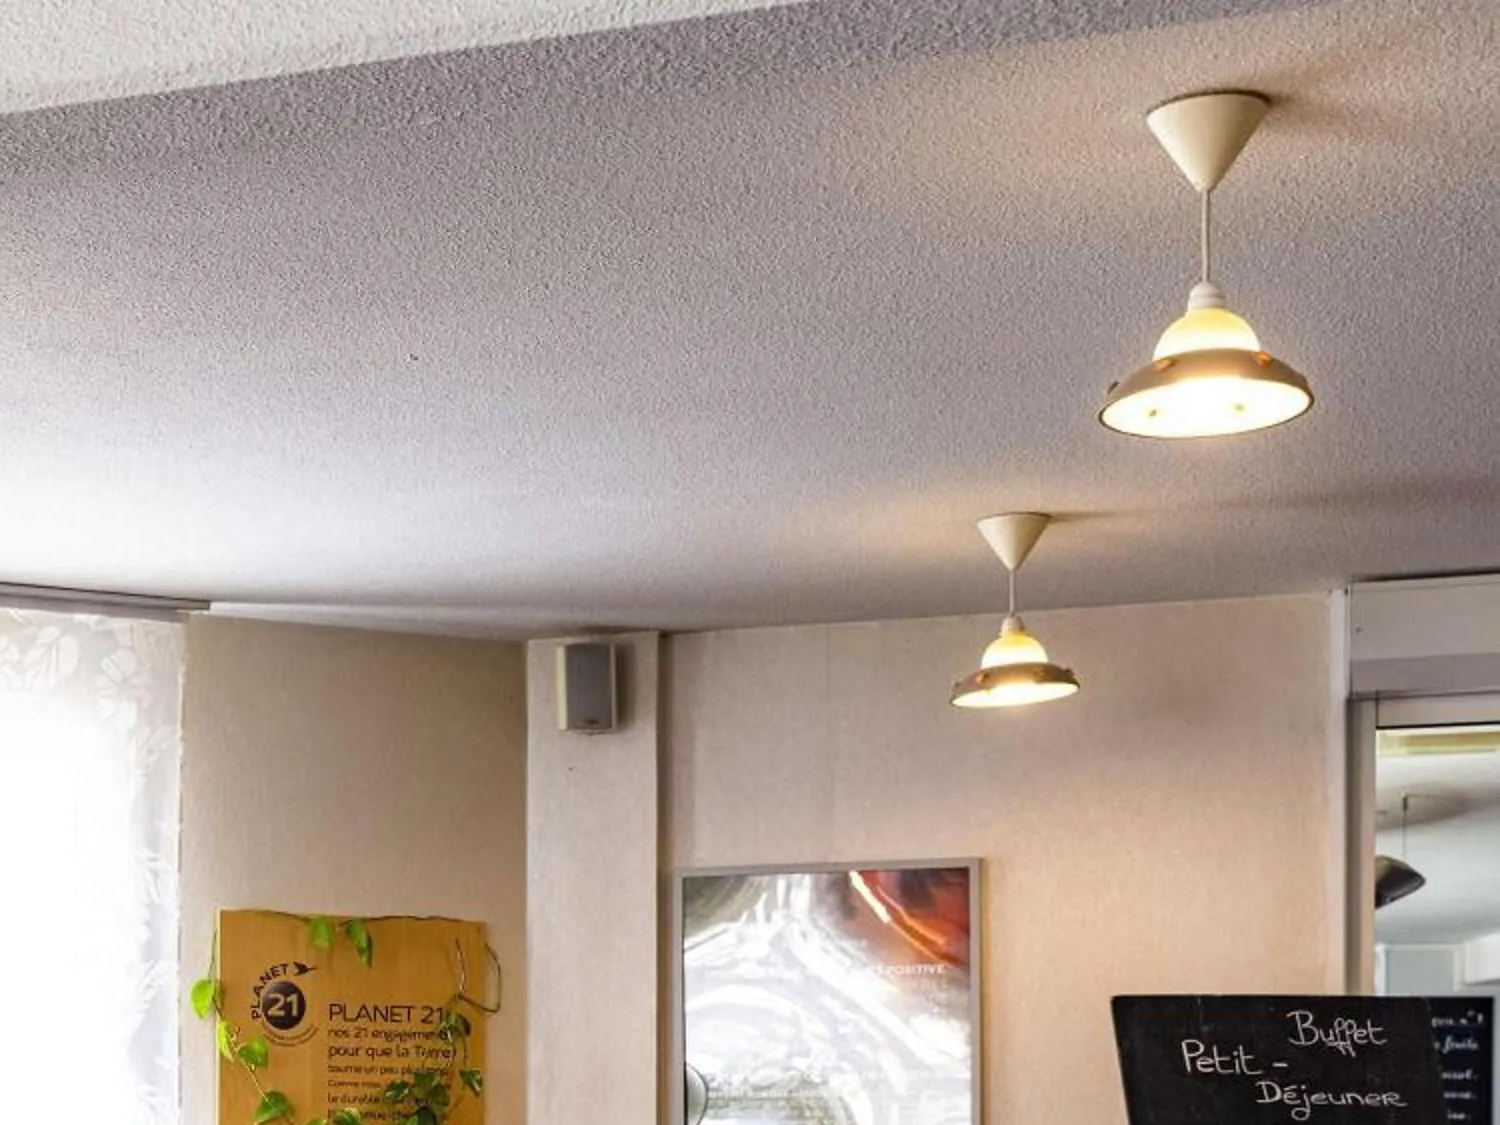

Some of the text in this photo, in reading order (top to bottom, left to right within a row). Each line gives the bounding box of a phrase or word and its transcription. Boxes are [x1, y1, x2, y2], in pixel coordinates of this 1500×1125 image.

[251, 964, 288, 1019] PLANET
[267, 993, 298, 1017] 21
[329, 1004, 444, 1024] PLANET 21
[1286, 1010, 1388, 1057] Buffet
[1181, 1039, 1264, 1075] Petit
[1255, 1081, 1409, 1121] Déjeuner
